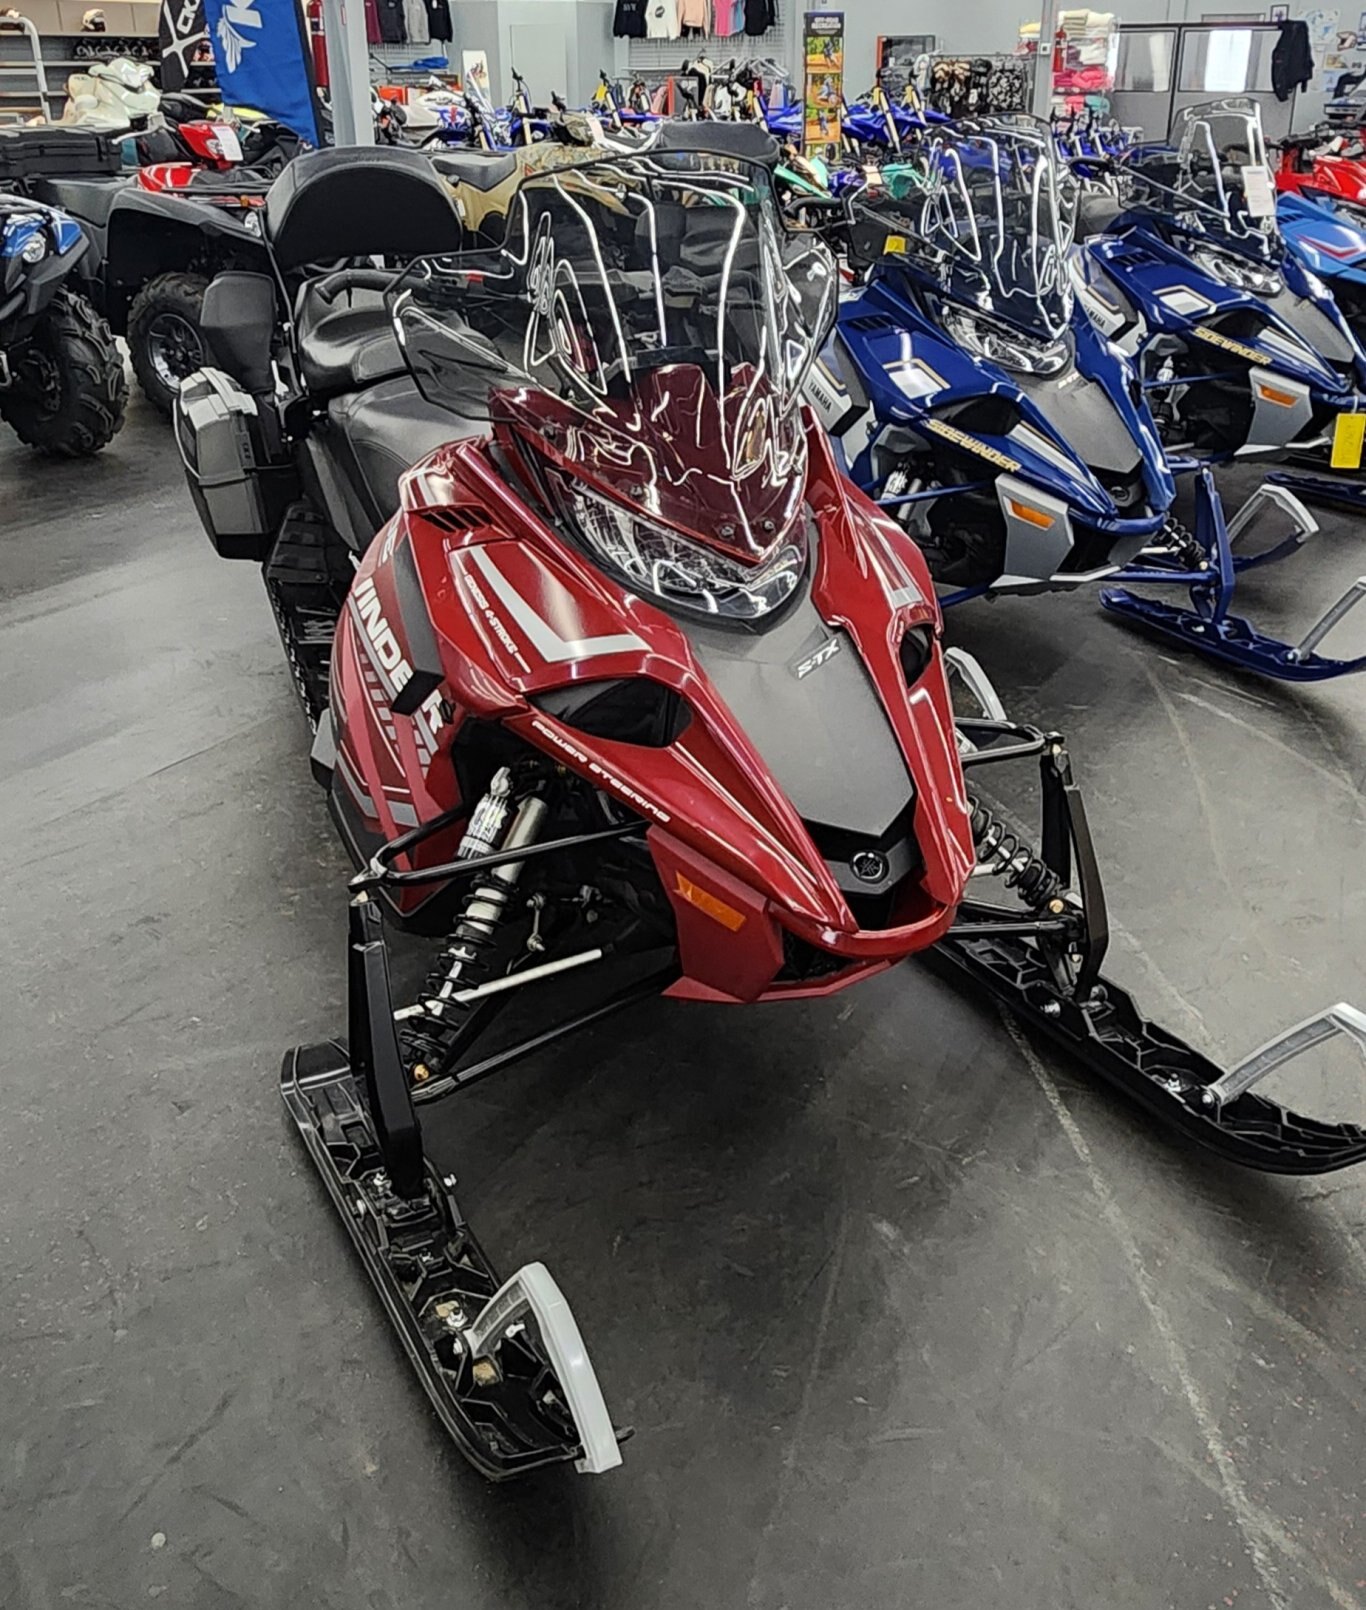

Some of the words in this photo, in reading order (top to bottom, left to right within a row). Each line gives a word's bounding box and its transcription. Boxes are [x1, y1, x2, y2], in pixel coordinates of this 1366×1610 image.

[1193, 326, 1273, 366] SIDEWINDER
[808, 381, 832, 413] YAMAHA
[925, 418, 1022, 473] SIDEWINDER
[484, 609, 519, 654] 4-STROKE
[797, 638, 840, 679] S-TX
[531, 719, 588, 763] POWER
[588, 762, 671, 823] STEERING
